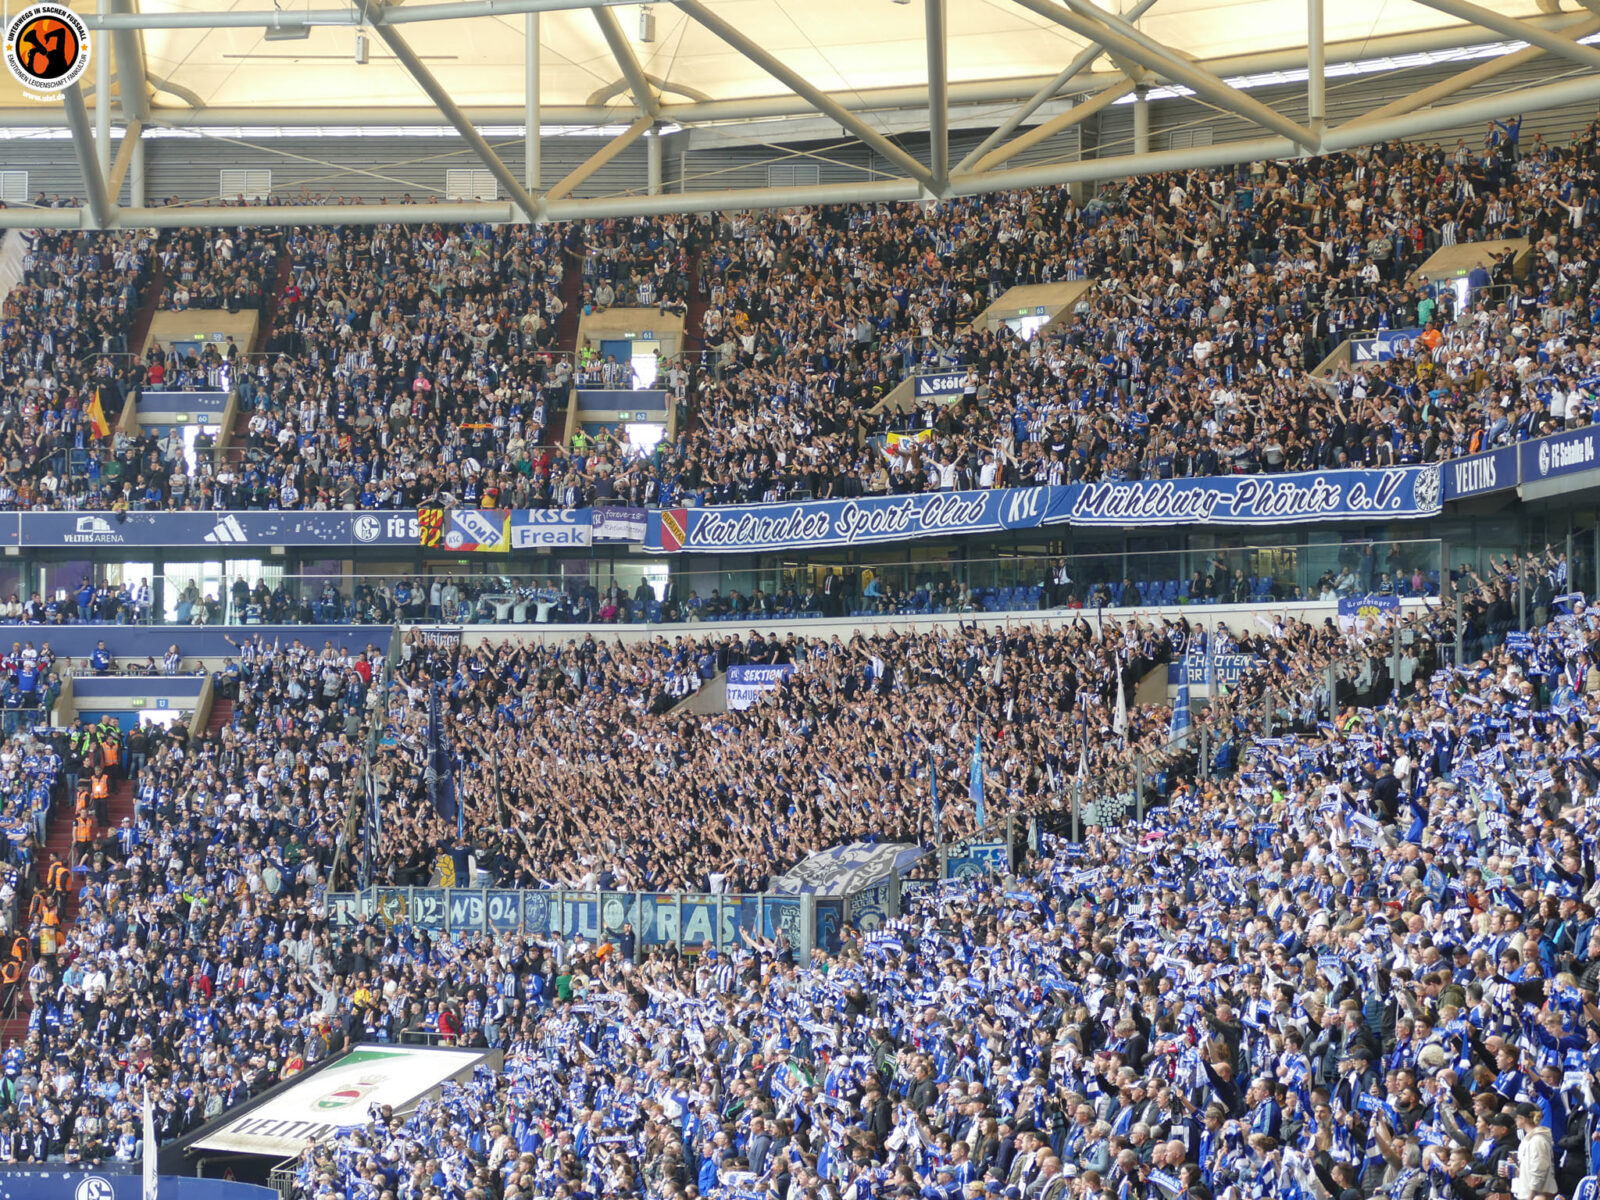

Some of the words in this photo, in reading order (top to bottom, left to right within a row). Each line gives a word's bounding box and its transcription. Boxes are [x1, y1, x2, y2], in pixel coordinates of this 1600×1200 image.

[932, 373, 967, 391] Stölt
[1456, 455, 1496, 494] VELTINS
[1007, 486, 1044, 523] KSC
[1072, 477, 1341, 521] Mühlburg-Phönix
[1347, 471, 1407, 511] e.V.
[528, 508, 576, 523] KSC
[690, 508, 830, 545] Karlsruher
[836, 492, 990, 543] Sport-Club
[95, 534, 124, 543] ARENA
[520, 527, 585, 545] Freak
[1188, 655, 1251, 667] CHOTEN
[743, 668, 784, 682] SEKTION
[231, 1118, 338, 1141] VELTIN
